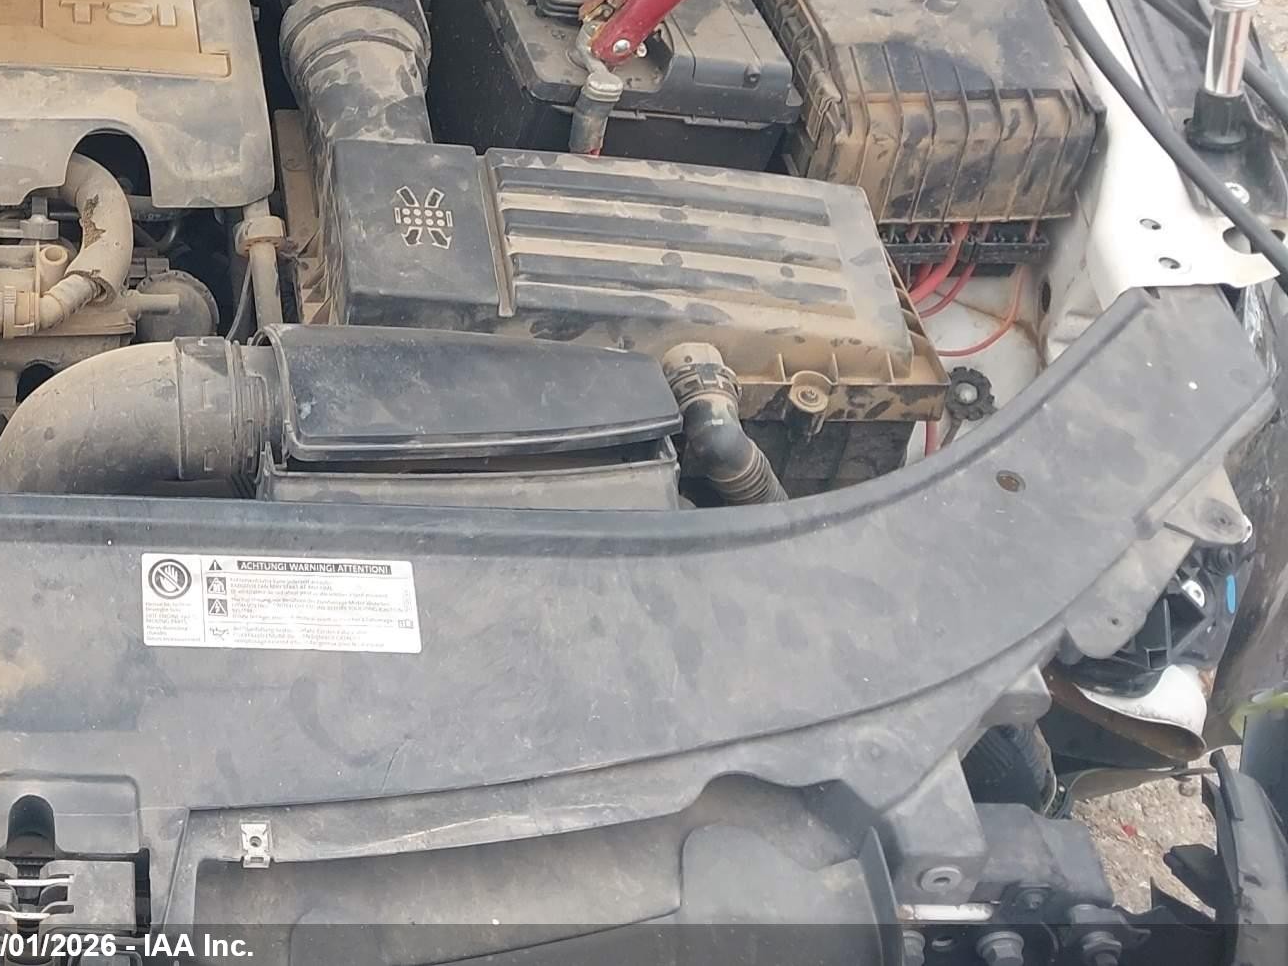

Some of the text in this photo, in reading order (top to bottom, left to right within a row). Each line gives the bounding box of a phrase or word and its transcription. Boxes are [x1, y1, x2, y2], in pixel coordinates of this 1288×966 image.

[59, 0, 177, 27] TSI
[240, 561, 389, 574] ACHTUNG! WARNING! ATTENTION!
